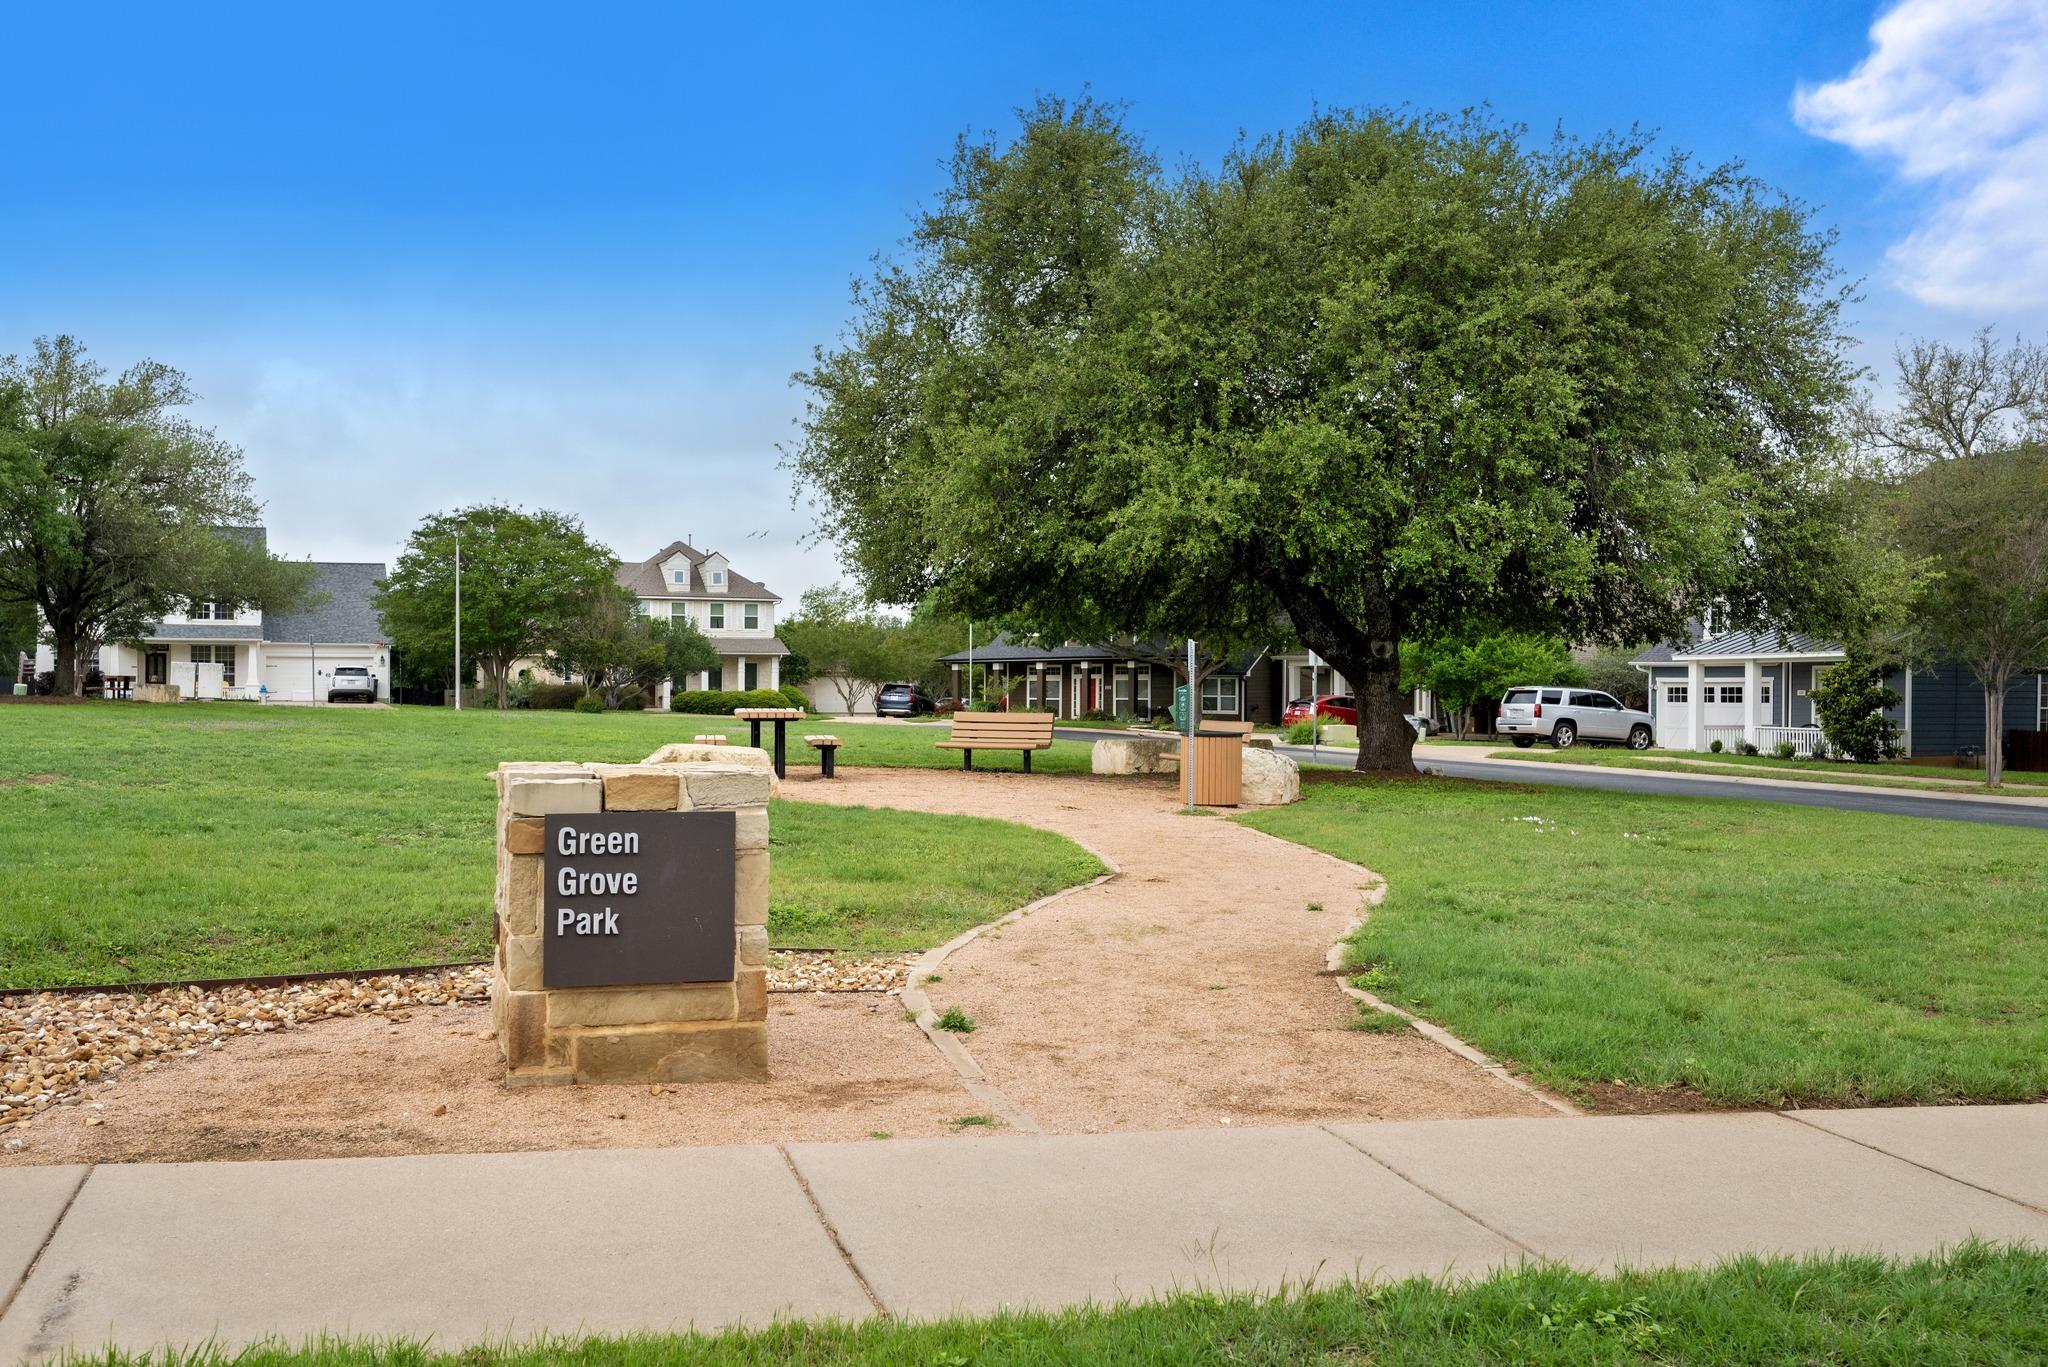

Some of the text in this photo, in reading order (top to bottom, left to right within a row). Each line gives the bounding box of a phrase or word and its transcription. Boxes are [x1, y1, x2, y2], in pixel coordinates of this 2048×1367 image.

[557, 826, 640, 856] Green
[557, 867, 639, 896] Grove
[557, 907, 620, 936] Park
